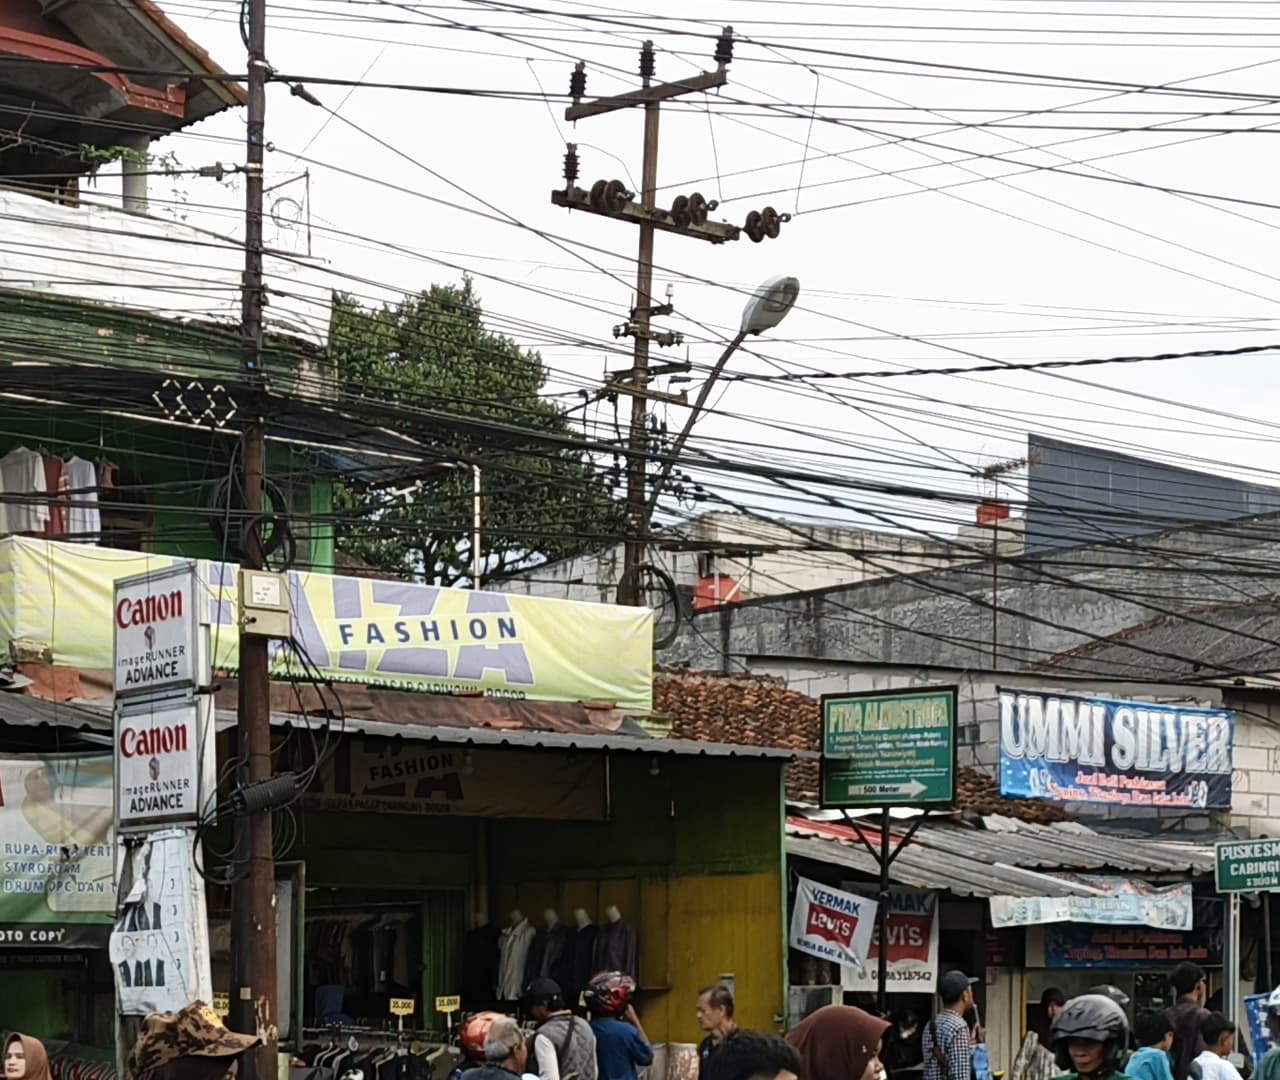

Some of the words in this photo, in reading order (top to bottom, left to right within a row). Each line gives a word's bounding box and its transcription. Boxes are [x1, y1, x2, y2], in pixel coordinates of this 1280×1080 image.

[116, 589, 183, 629] Canon
[339, 617, 518, 645] FASHION
[118, 645, 185, 667] imageRUNNER
[125, 660, 179, 685] ADVANCE
[119, 723, 187, 759] Canon
[999, 692, 1107, 767] UMMI
[1111, 705, 1234, 775] SILVER
[369, 753, 454, 782] FASHION
[122, 778, 190, 797] imageRUNNER
[129, 793, 185, 814] ADVANCE
[4, 863, 81, 874] STYROFOAM
[4, 880, 42, 893] DRUM
[77, 882, 104, 893] DAN
[812, 887, 861, 916] VERMAK
[30, 929, 64, 942] COPY
